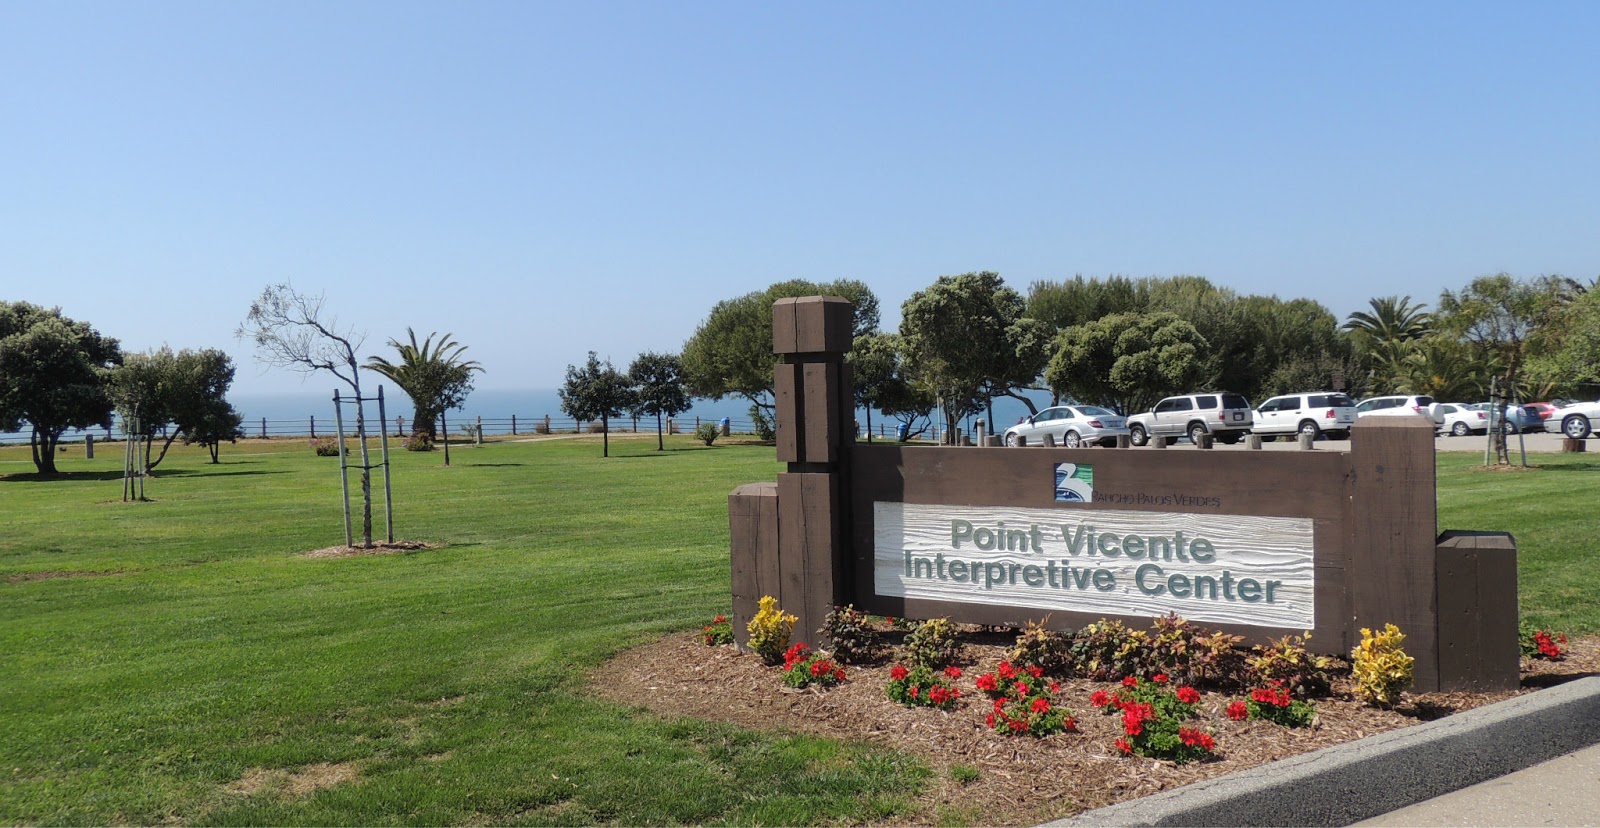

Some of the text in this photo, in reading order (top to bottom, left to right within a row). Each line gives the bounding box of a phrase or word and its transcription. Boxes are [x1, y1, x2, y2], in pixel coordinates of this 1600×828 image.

[1092, 490, 1221, 508] RANCHO PALOS VERDES
[951, 519, 1216, 563] Point Vicente
[904, 551, 1282, 602] Interpretive Center
